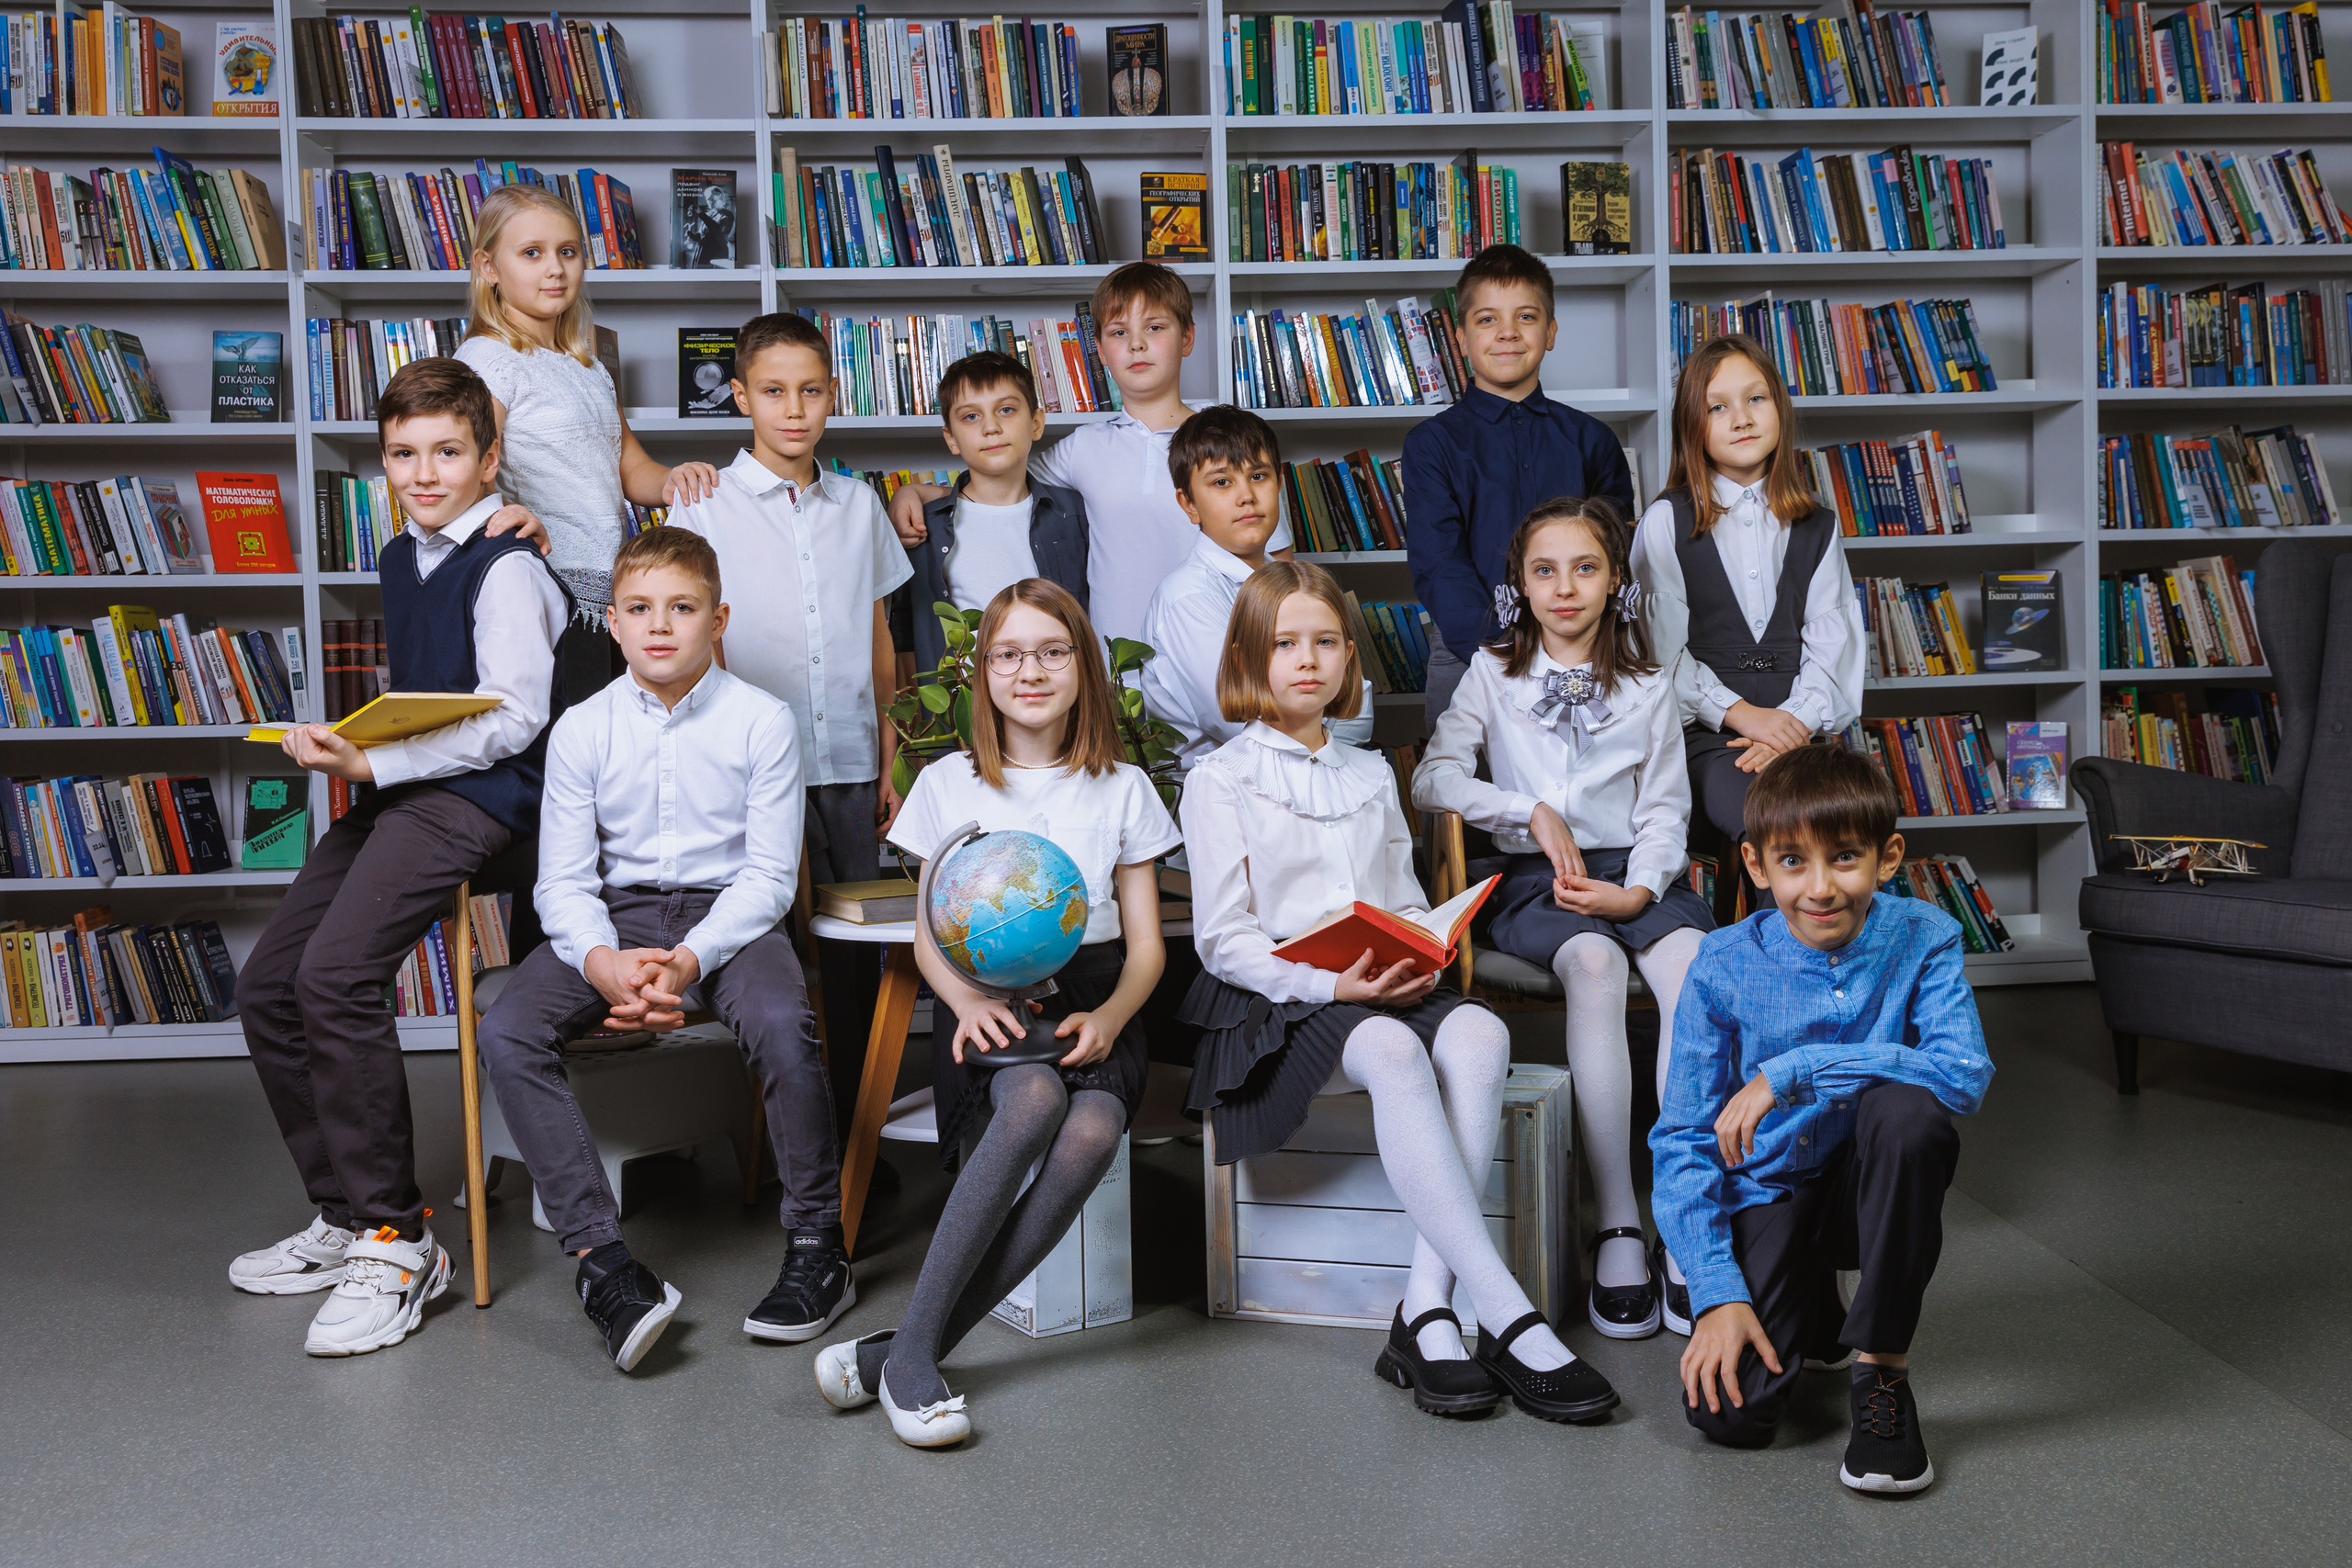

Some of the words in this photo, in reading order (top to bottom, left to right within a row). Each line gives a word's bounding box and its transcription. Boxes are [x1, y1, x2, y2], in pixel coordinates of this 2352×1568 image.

[944, 24, 953, 57] МЕТЕОРОЛОГИЯ
[1115, 33, 1155, 42] ДРАГОЦЕННОСТИ
[1363, 28, 1374, 67] АБИТУРИЕНТОВ
[1244, 39, 1255, 80] БИОЛОГИЯ
[1306, 38, 1316, 112] БИОЛОГИЯ
[1382, 55, 1393, 92] БИОЛОГИЯ
[1567, 39, 1583, 83] БИОЛОГИЯ
[217, 103, 277, 114] ОТКРЫТИЯ
[1369, 79, 1377, 107] БИОЛОГИЯ
[10, 172, 24, 215] ЭКОЛОГИЯ
[23, 172, 37, 215] ЭКОЛОГИЯ
[857, 173, 865, 199] ГЕОГРАФИЯ
[942, 159, 960, 218] ЛАНДШАФТЫ
[1785, 171, 1797, 201] МЕХАНИКА
[1899, 150, 1920, 212] Гидравлика
[4, 179, 17, 223] ЭКОЛОГИИ
[432, 195, 449, 243] ФИЗИКА
[840, 191, 849, 228] ГЕОГРАФИЯ
[849, 197, 857, 225] ГЕОГРАФИЯ
[1493, 179, 1505, 243] БИОЛОГИ
[2117, 178, 2134, 231] Internet
[166, 217, 181, 248] ЭКОЛОГИЯ
[200, 220, 219, 259] ЭКОЛОГИЯ
[317, 206, 325, 248] МЕХАНИКА
[13, 229, 22, 265] ОСНОВЫ
[2150, 326, 2157, 339] XP
[239, 365, 257, 373] КАК
[2150, 340, 2160, 371] Windows
[219, 376, 275, 385] ОТКАЗАТЬСЯ
[219, 397, 274, 406] ПЛАСТИКА
[206, 487, 276, 498] МАТЕМАТИЧЕСКИЕ
[212, 496, 274, 505] ГОЛОВОЛОМКИ
[32, 494, 60, 567] МАТЕМАТИКА
[1988, 591, 2018, 600] Банки
[2019, 592, 2055, 601] данных
[103, 633, 121, 682] МАТЕМАТИКА
[1971, 740, 1981, 777] WINDOWS
[1981, 780, 1988, 790] XP
[15, 787, 28, 830] ИНФОРМАТИКА
[8, 830, 21, 857] 3000
[25, 838, 36, 874] МАТЕМАТИКА
[57, 954, 74, 1010] ТРИГОНОМЕТРИЯ
[103, 949, 116, 990] ОПТИМИЗАЦИИ
[12, 983, 22, 1009] ГЕОМЕТРИЯ
[29, 983, 40, 1009] ГЕОМЕТРИЯ
[111, 991, 120, 1014] МЕТОДЫ
[795, 1237, 820, 1247] adidas
